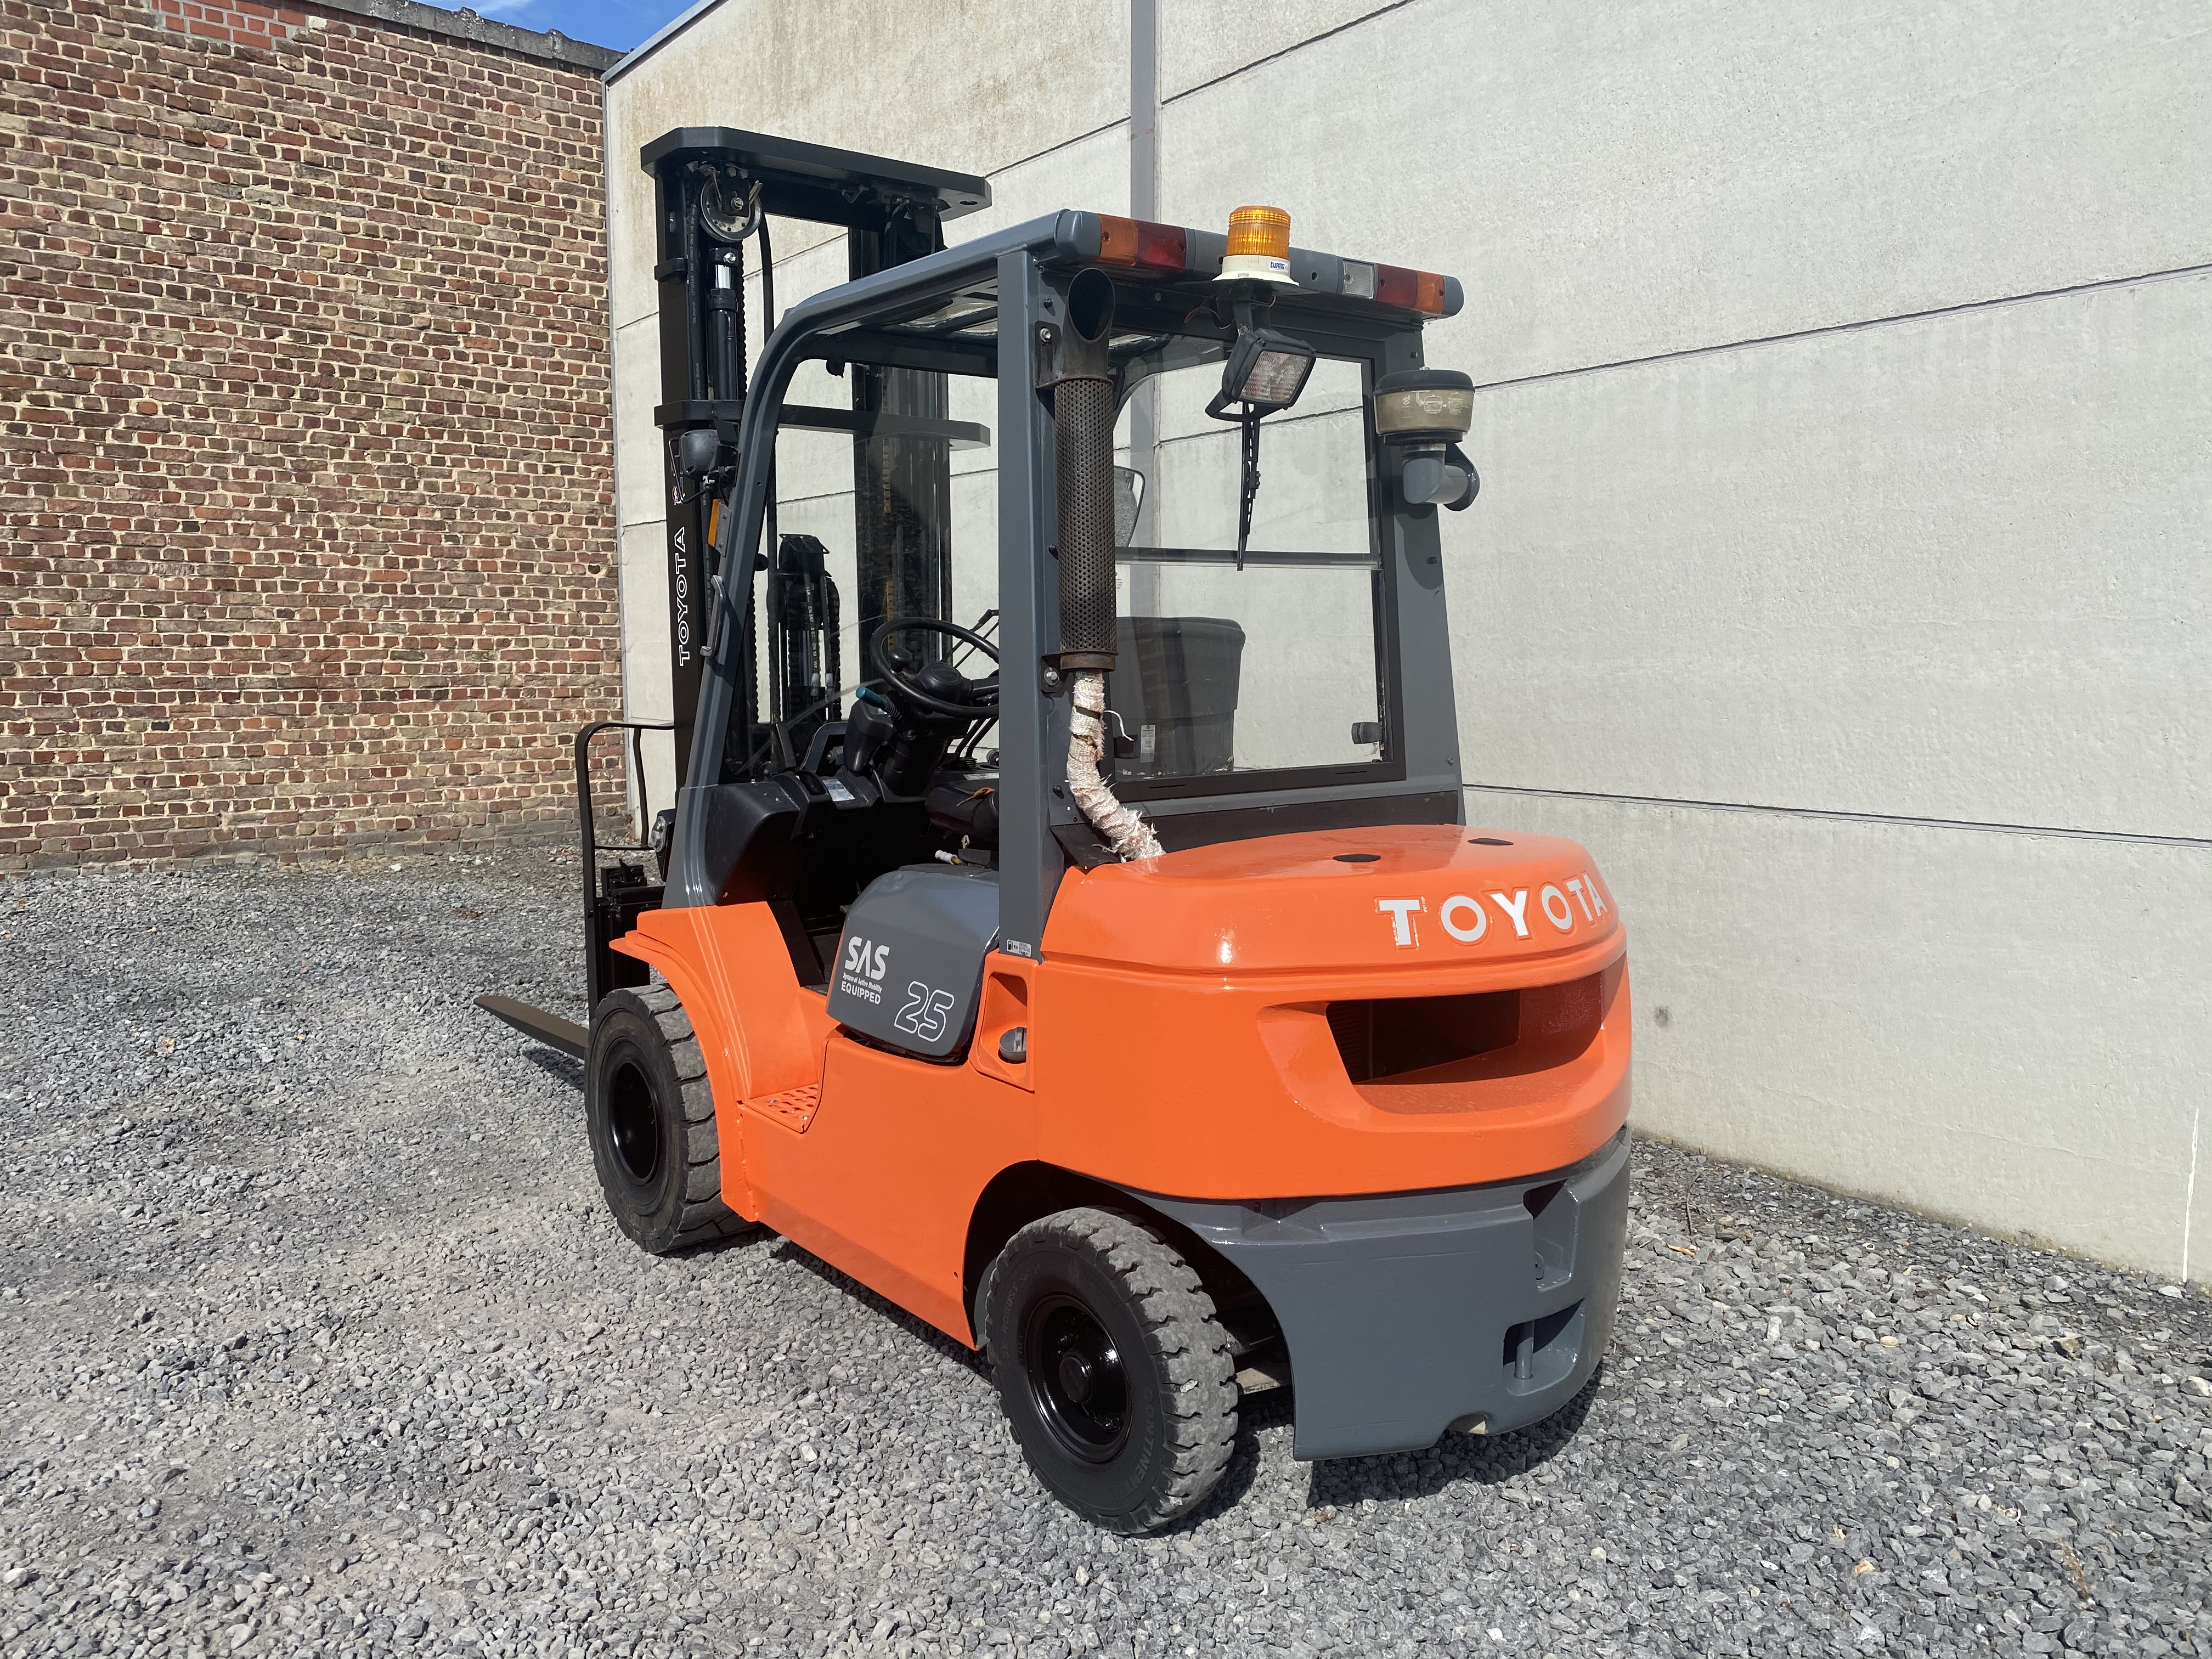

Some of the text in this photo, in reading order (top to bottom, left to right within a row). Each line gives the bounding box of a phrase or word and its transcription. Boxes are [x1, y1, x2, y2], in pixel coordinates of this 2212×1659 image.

[674, 526, 690, 667] TOYOTA
[1379, 874, 1608, 945] TOYOTA
[843, 972, 855, 982] System
[858, 978, 868, 988] Active
[868, 981, 883, 994] Stability
[844, 936, 890, 980] SAS
[841, 980, 881, 1005] EQUIPPED
[894, 980, 955, 1042] 25
